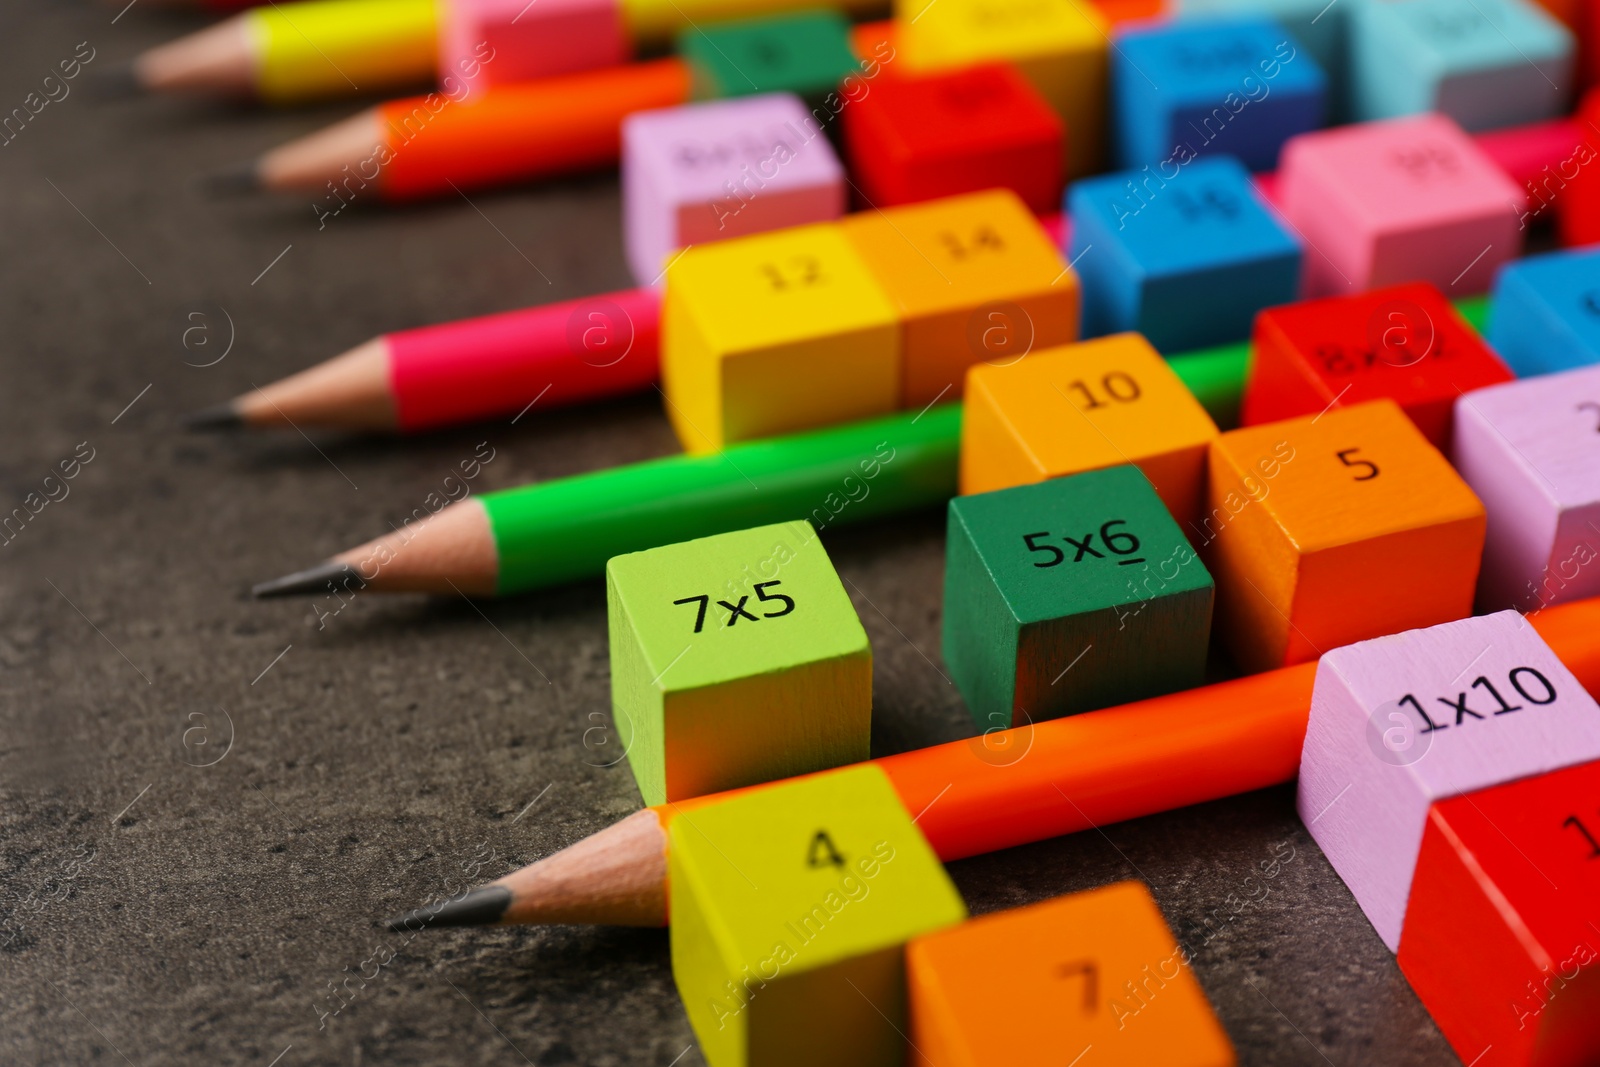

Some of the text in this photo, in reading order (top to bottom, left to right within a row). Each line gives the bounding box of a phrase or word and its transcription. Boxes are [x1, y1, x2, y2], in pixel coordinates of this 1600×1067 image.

[938, 225, 1005, 262] 14
[759, 255, 827, 291] 12
[1068, 371, 1142, 411] 10
[1336, 448, 1380, 481] 5
[1022, 520, 1146, 568] 5x6
[673, 580, 796, 633] 7x5
[1398, 666, 1558, 735] 1x10
[806, 829, 846, 870] 4
[1056, 959, 1099, 1019] 7
